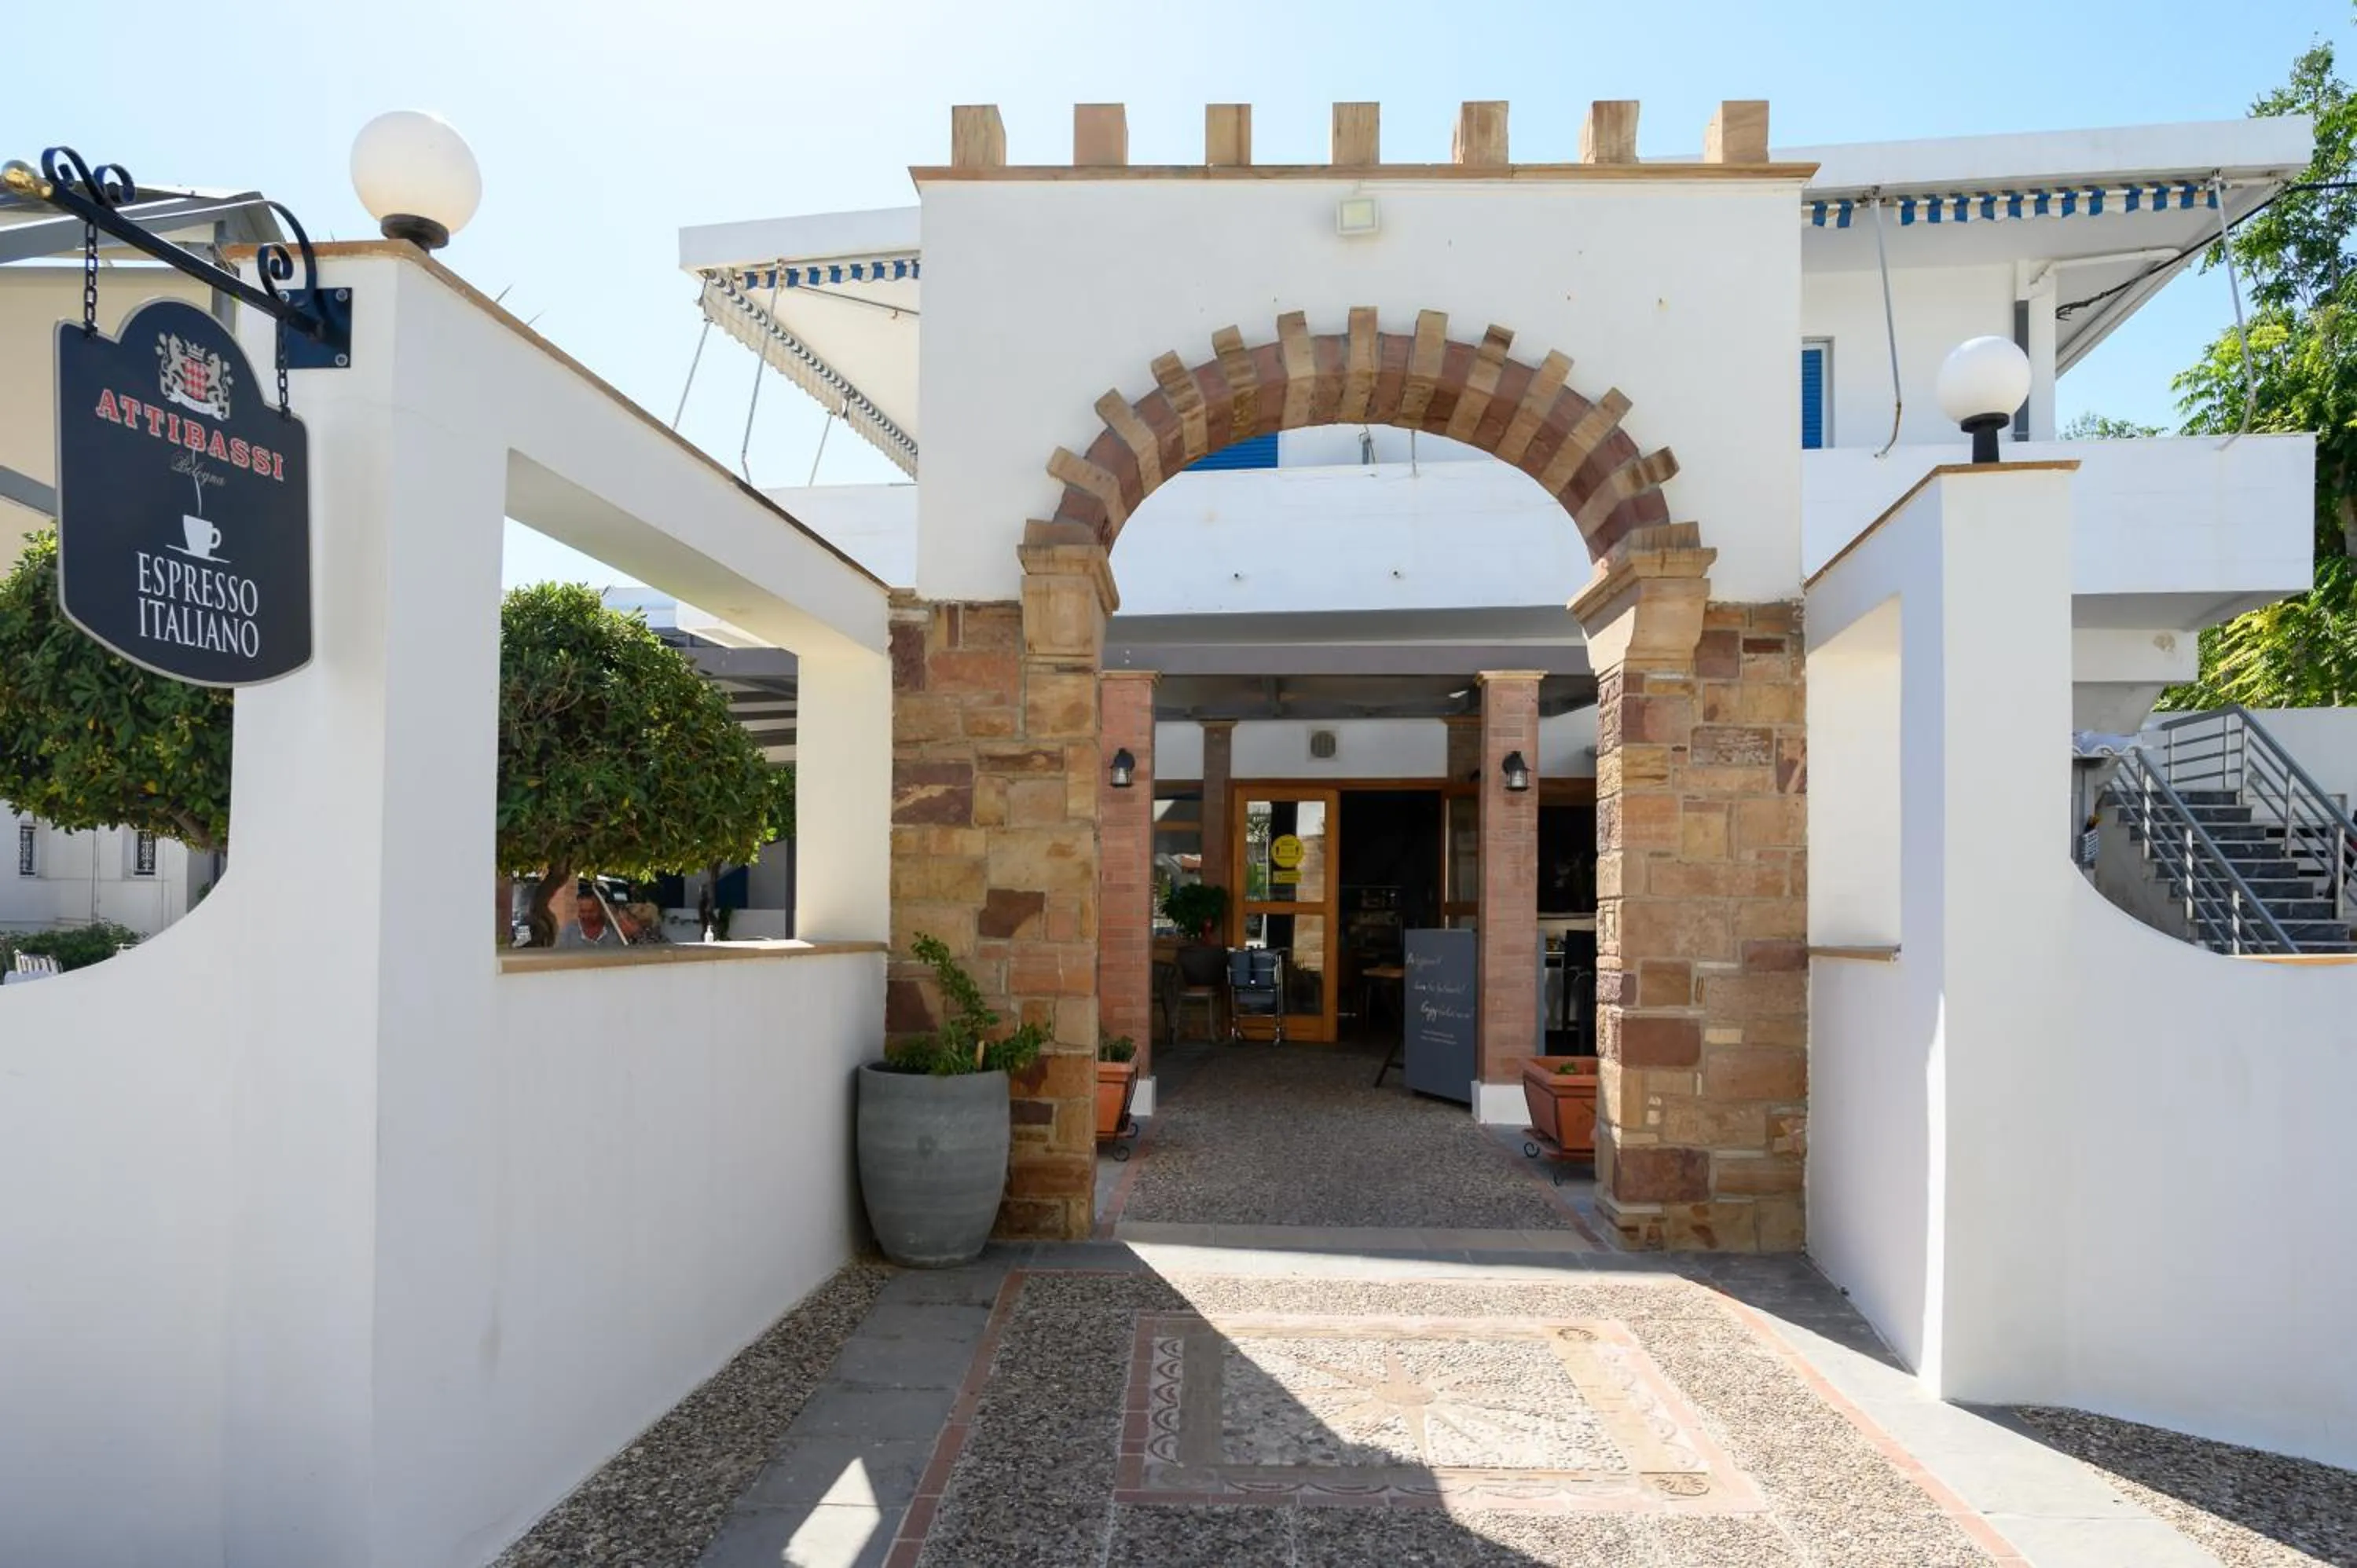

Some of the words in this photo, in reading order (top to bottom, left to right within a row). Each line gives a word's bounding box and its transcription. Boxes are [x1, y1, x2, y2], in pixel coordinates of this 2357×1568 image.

[95, 389, 284, 482] ATTIBASSI
[137, 551, 258, 617] ESPRESSO
[138, 596, 259, 658] ITALIANO
